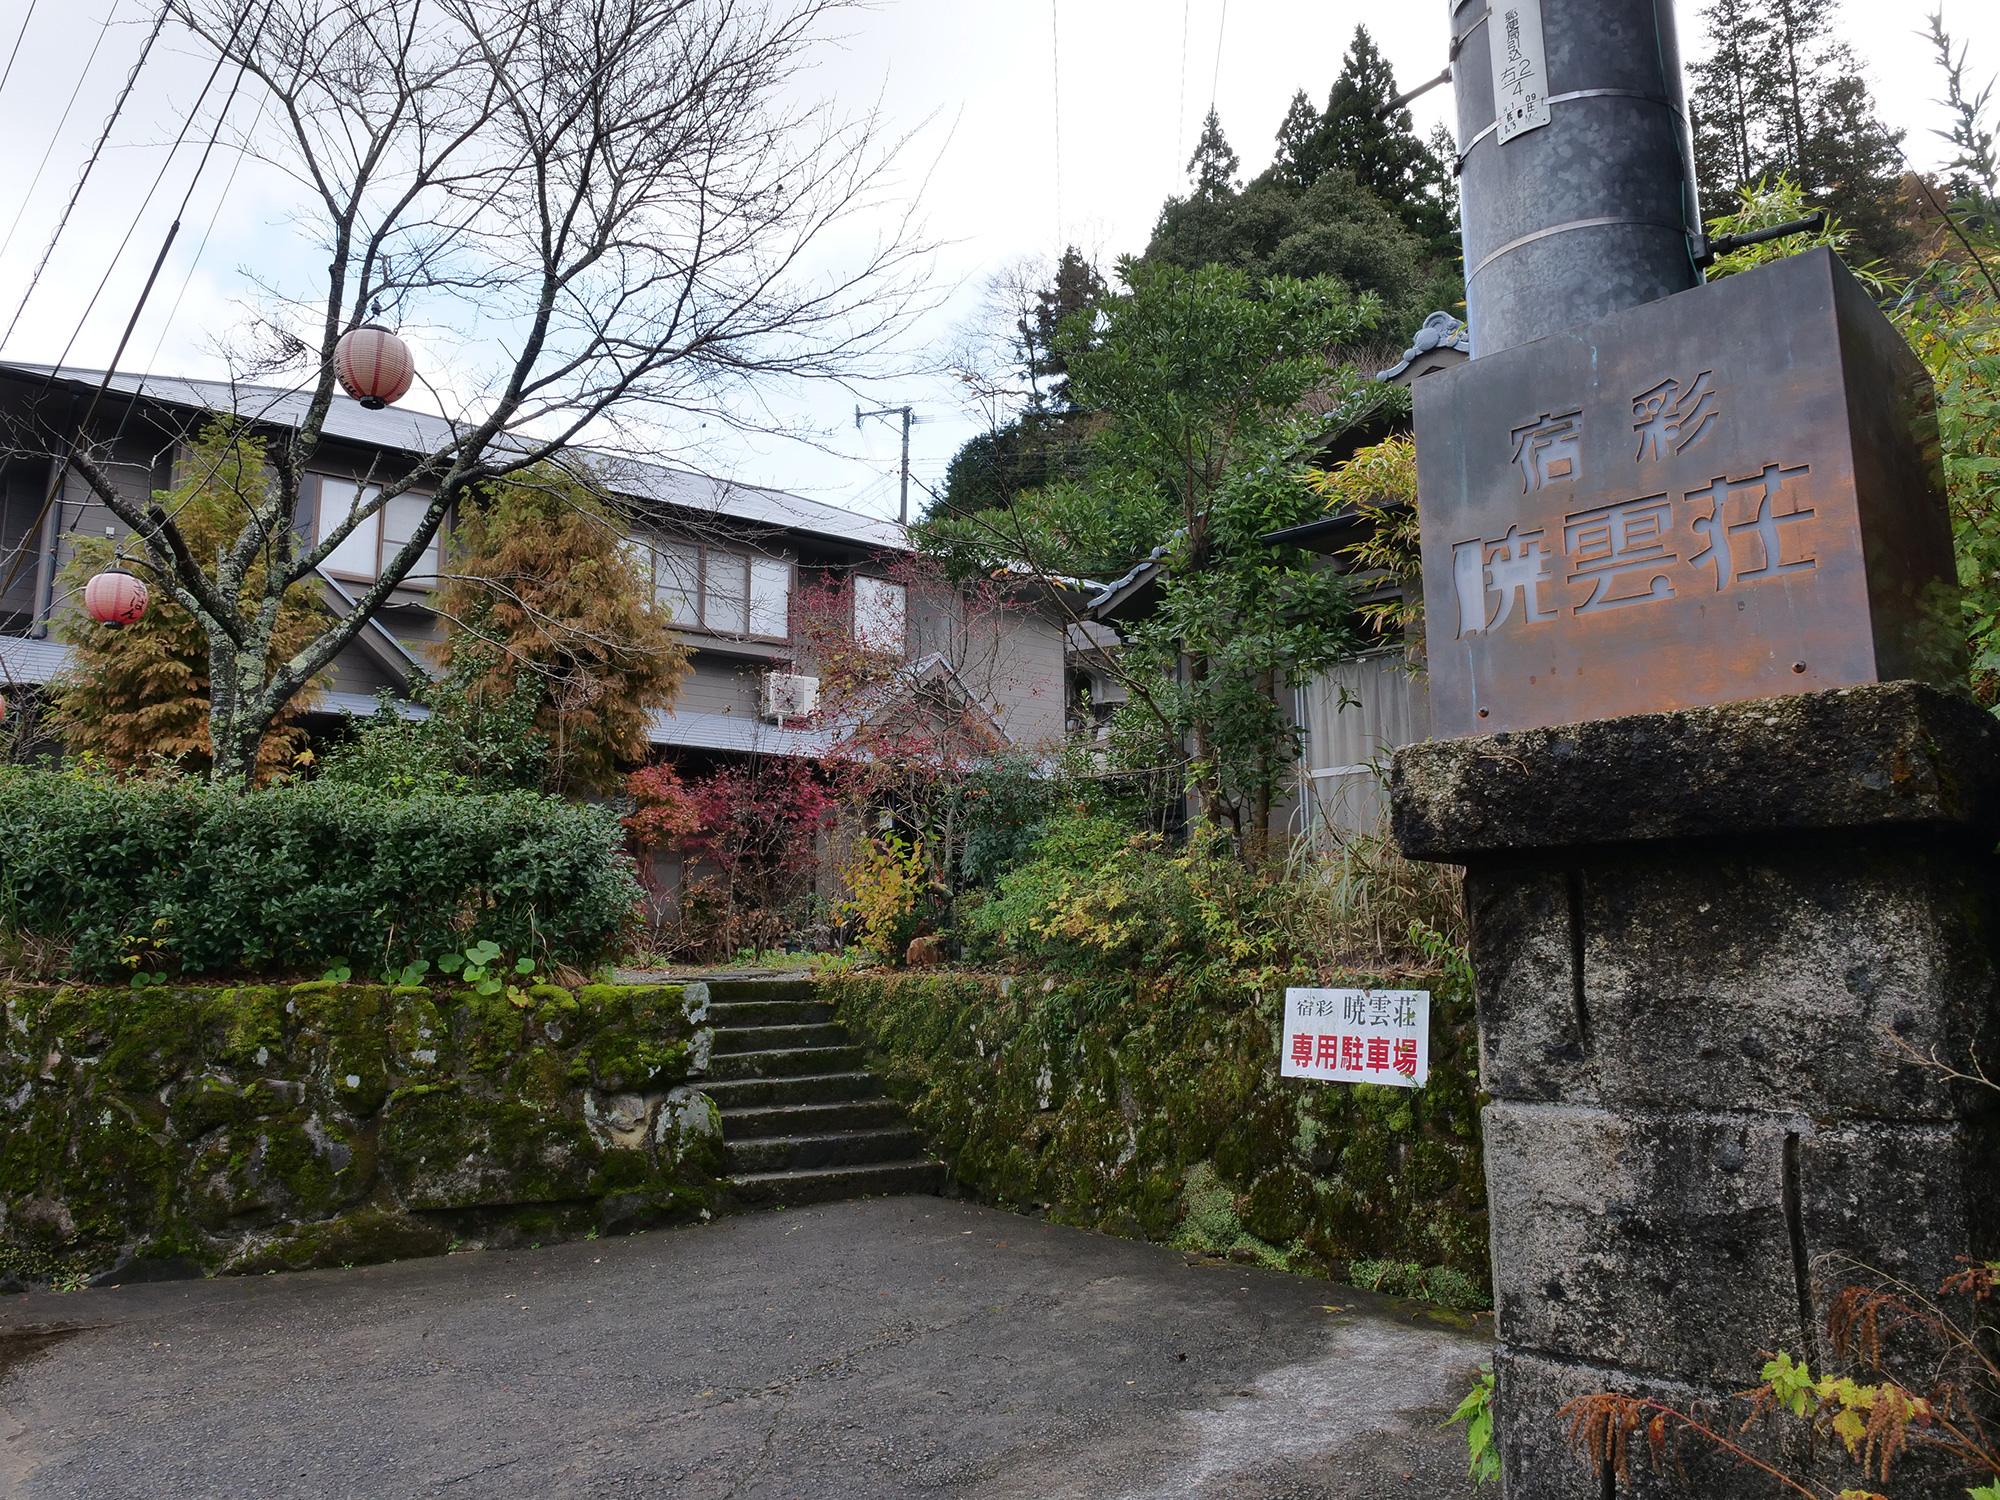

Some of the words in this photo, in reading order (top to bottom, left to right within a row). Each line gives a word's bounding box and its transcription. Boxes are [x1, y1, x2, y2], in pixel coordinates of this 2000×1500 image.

[1296, 999, 1333, 1017] 宿彩
[1343, 994, 1417, 1028] 暁雲荘
[1290, 1032, 1418, 1077] 専用駐車場
